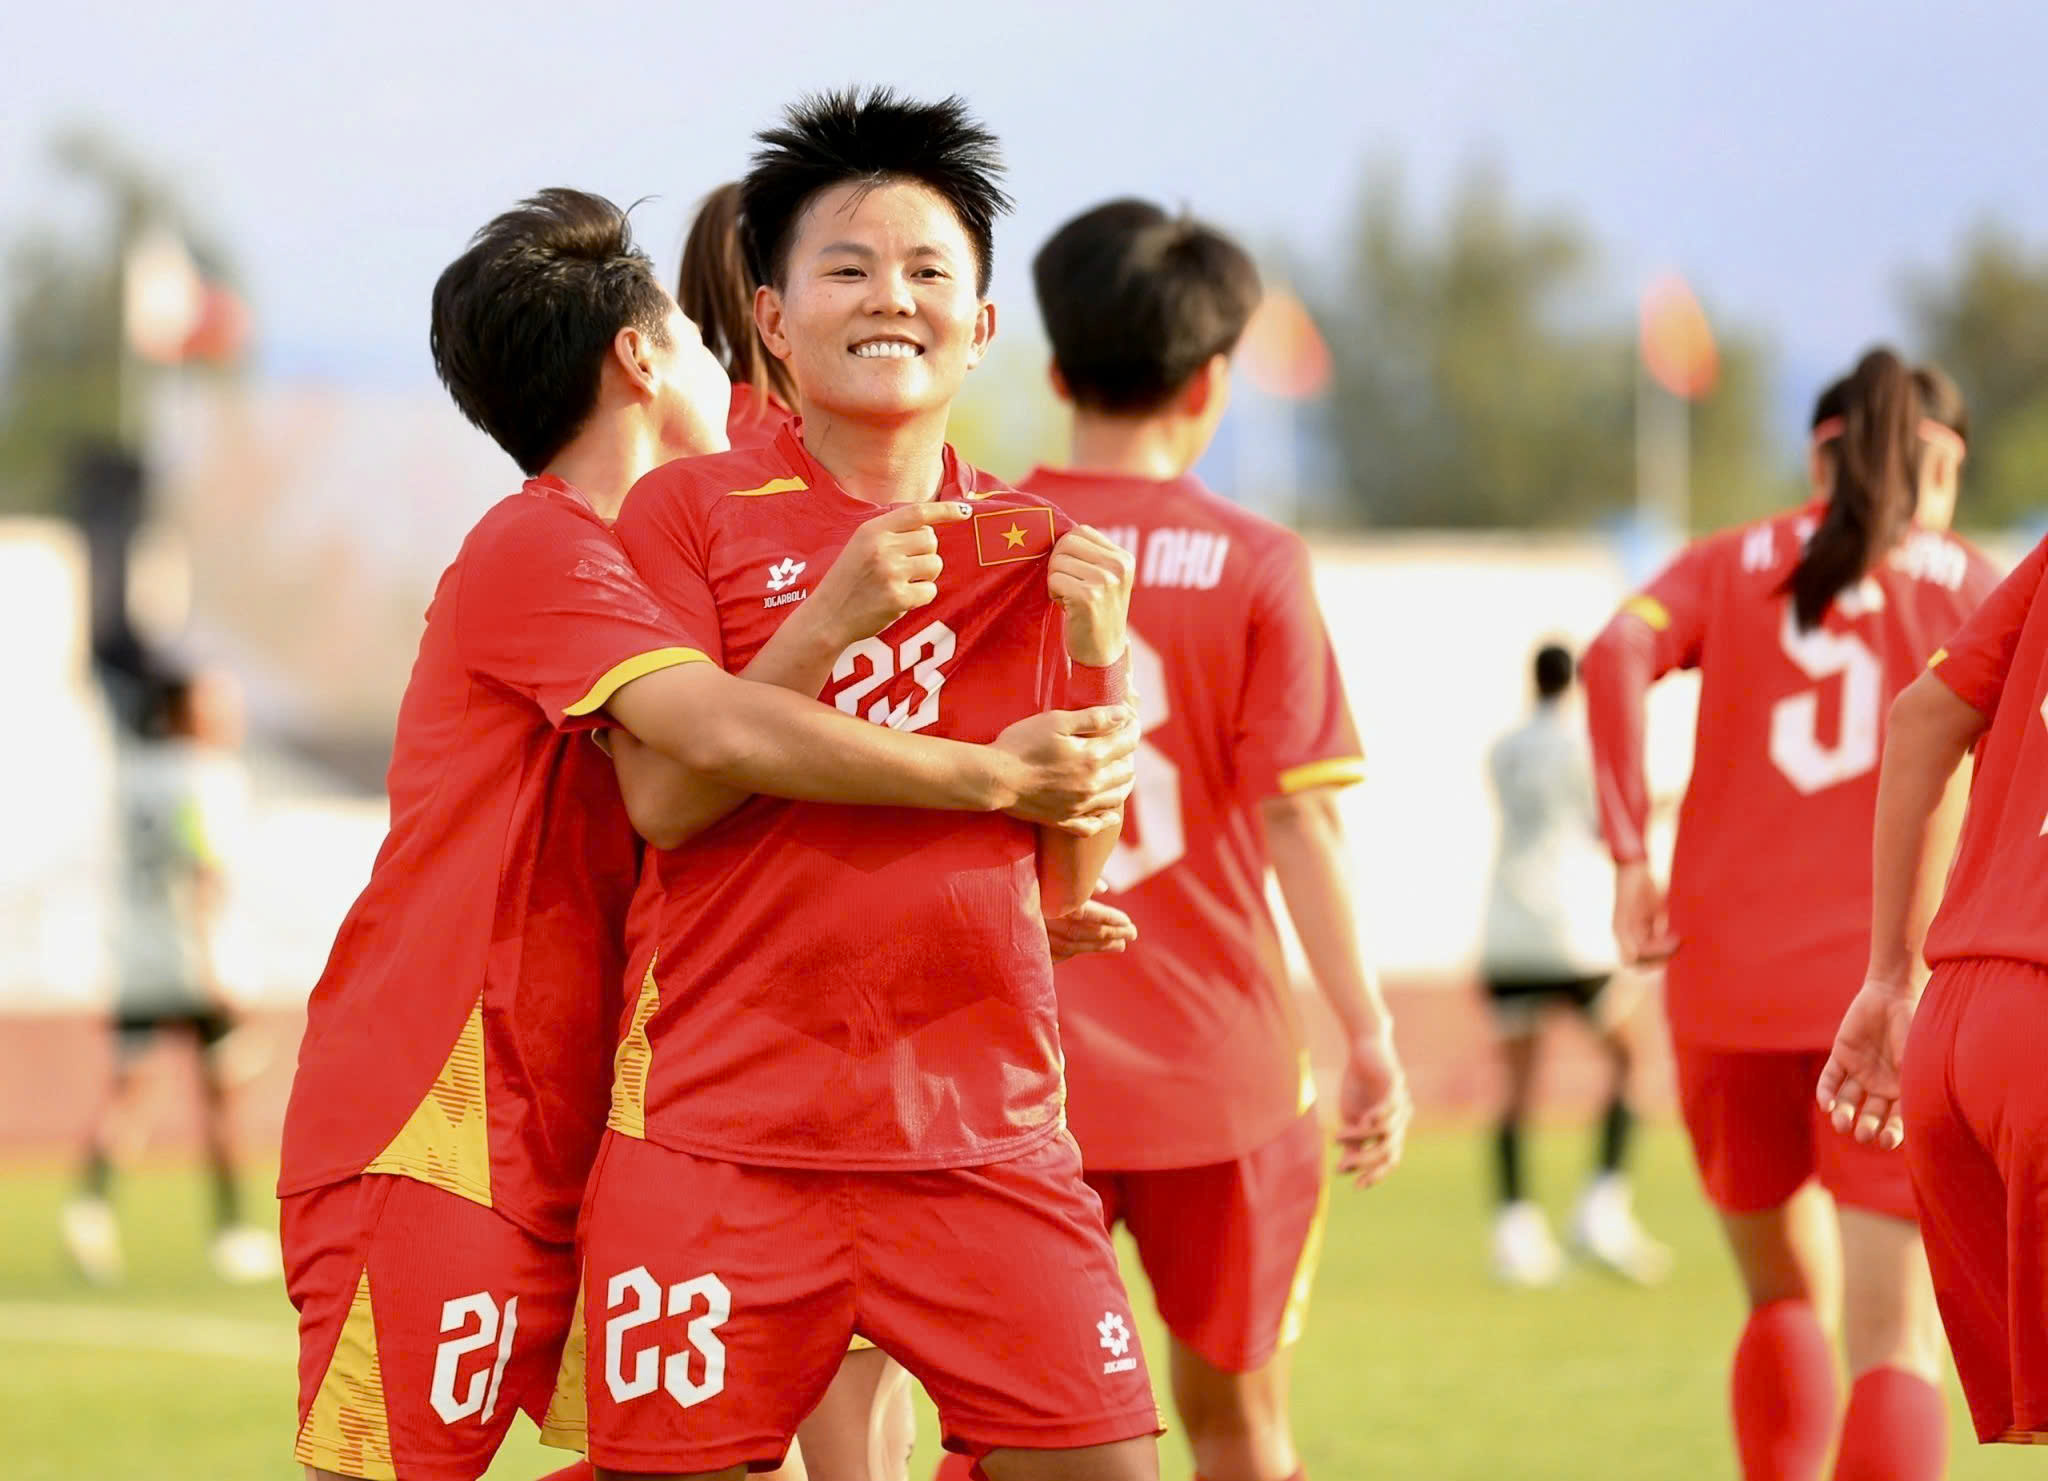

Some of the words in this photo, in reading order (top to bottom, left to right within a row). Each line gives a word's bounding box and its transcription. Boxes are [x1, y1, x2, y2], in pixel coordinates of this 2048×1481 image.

[763, 588, 807, 609] JOGARBOLA
[831, 619, 956, 733] 23
[1769, 576, 1885, 795] 5
[429, 1290, 519, 1425] 21
[605, 1265, 731, 1409] 23
